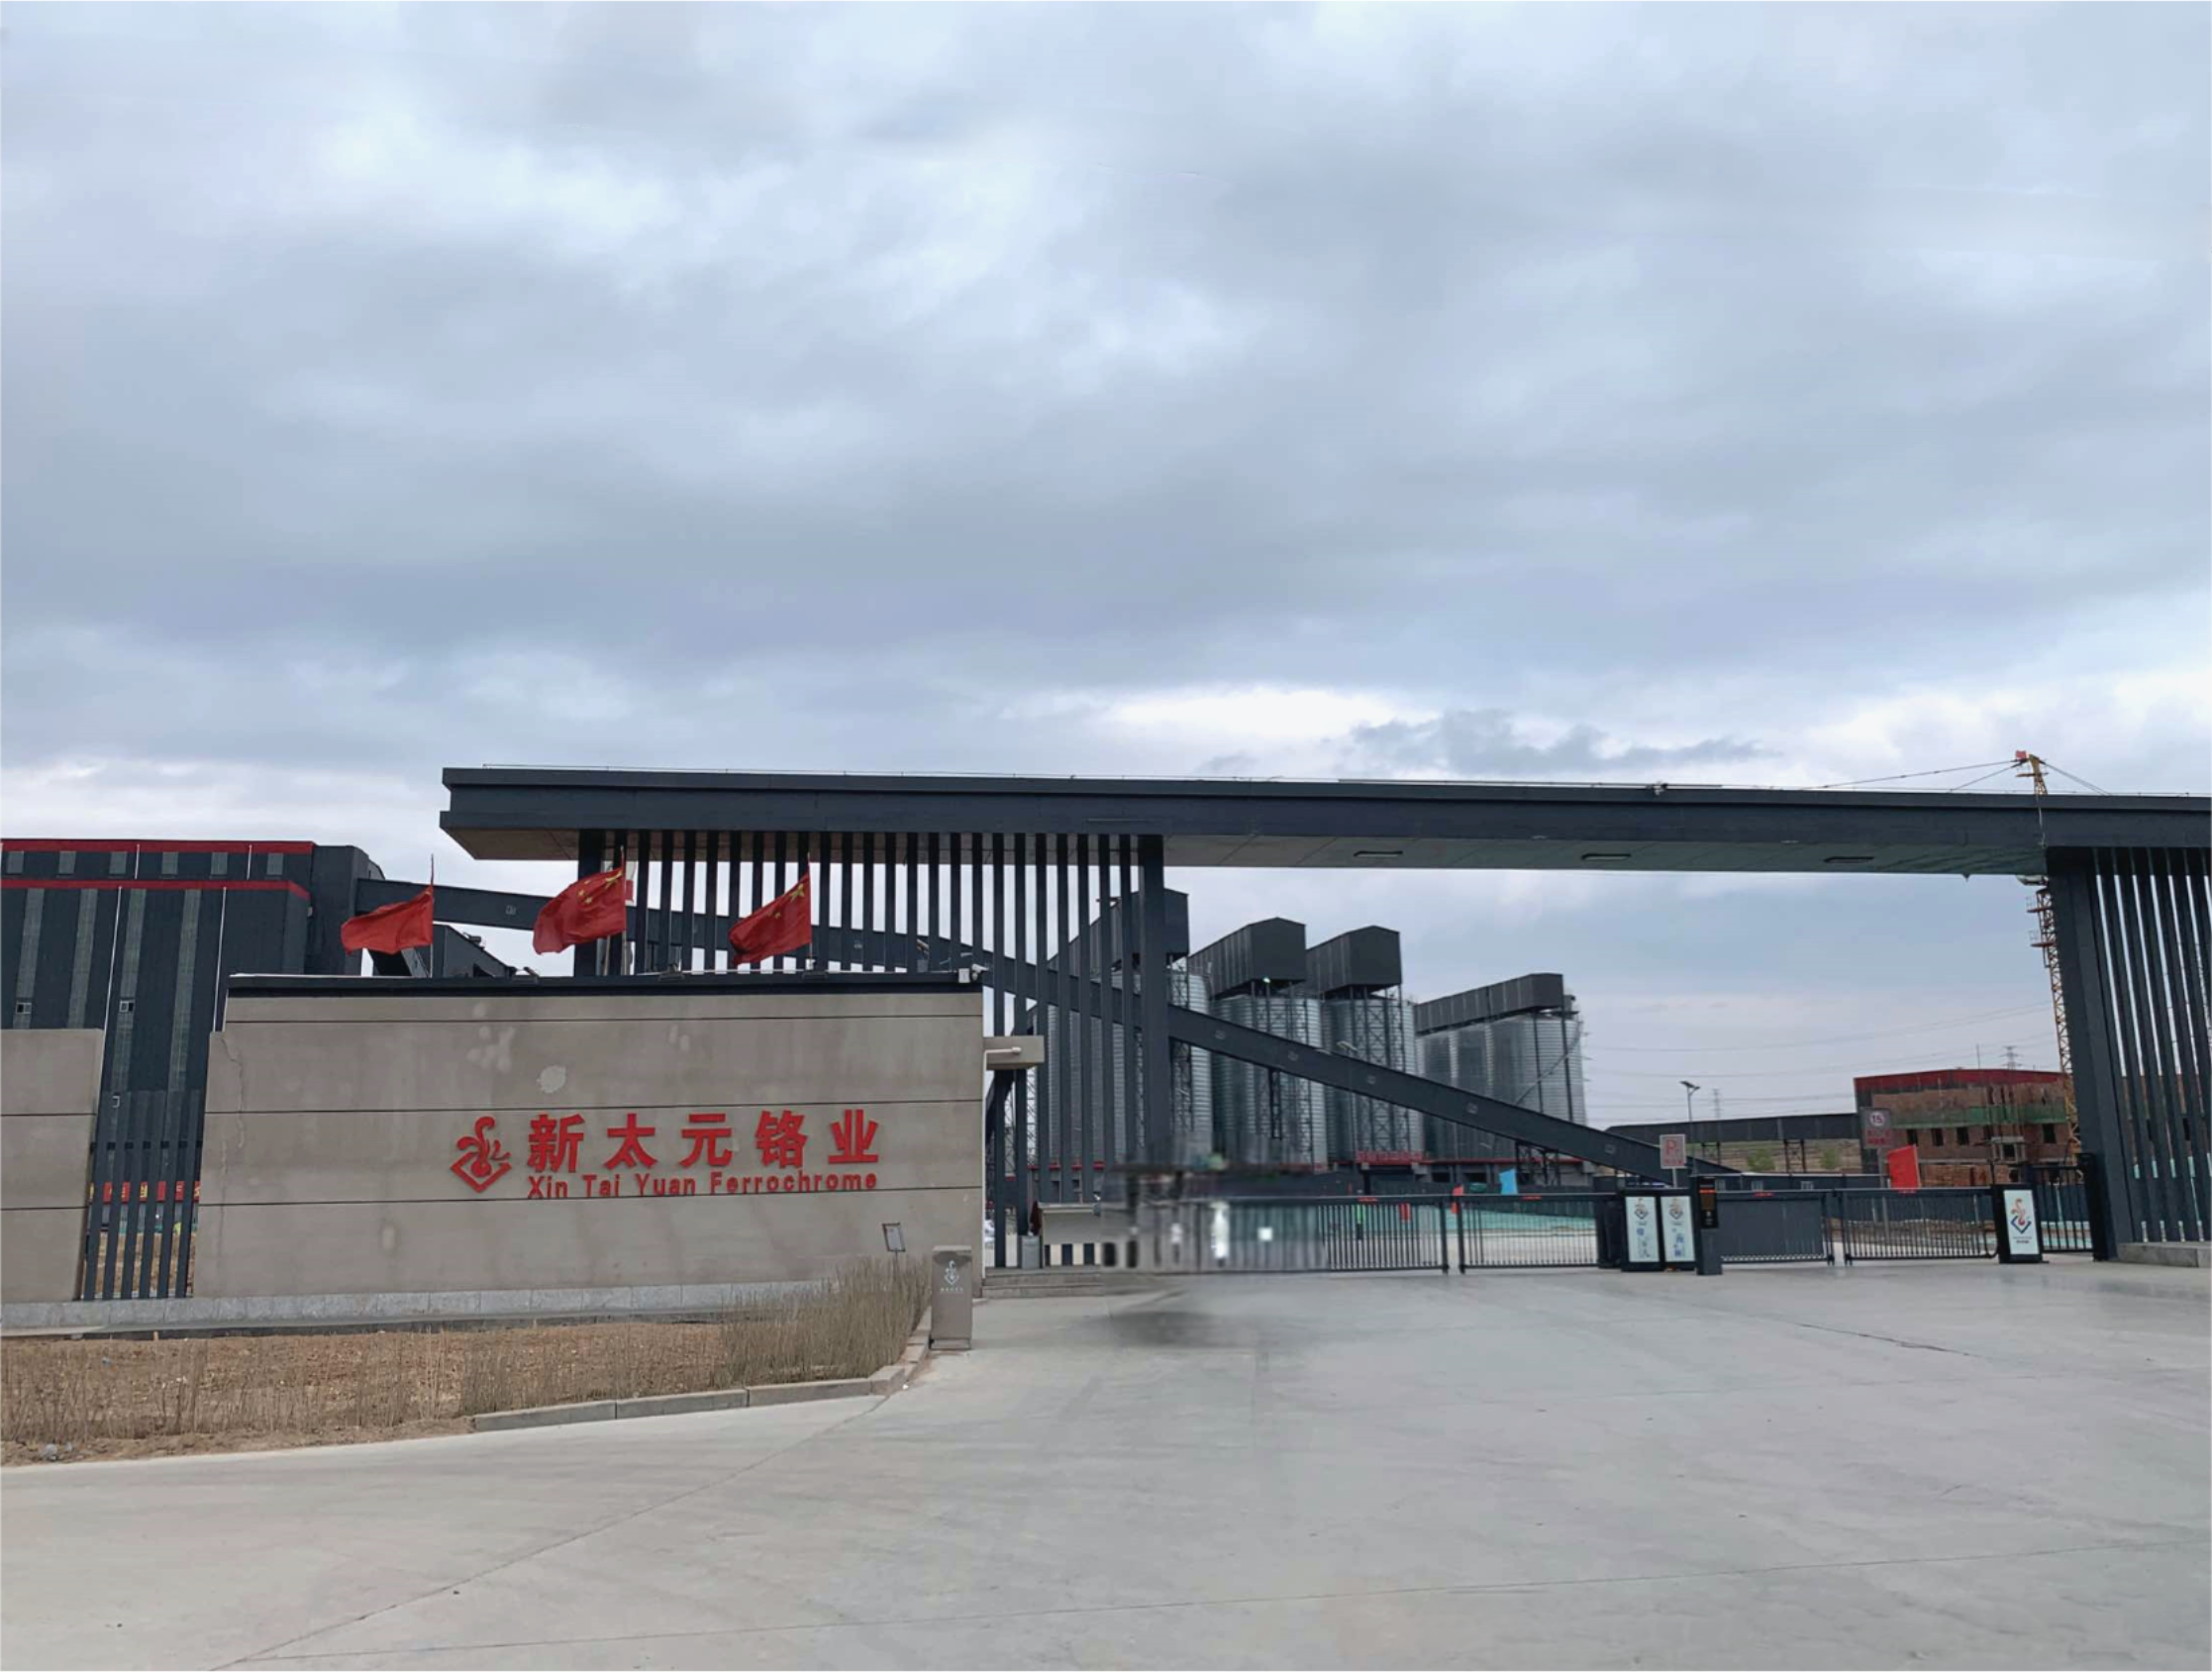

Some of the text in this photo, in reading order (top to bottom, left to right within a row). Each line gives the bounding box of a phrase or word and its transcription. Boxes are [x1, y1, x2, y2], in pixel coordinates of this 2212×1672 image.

[527, 1108, 879, 1173] 新太元铬业
[527, 1170, 878, 1199] Xin Tai Yuan Ferrochrome
